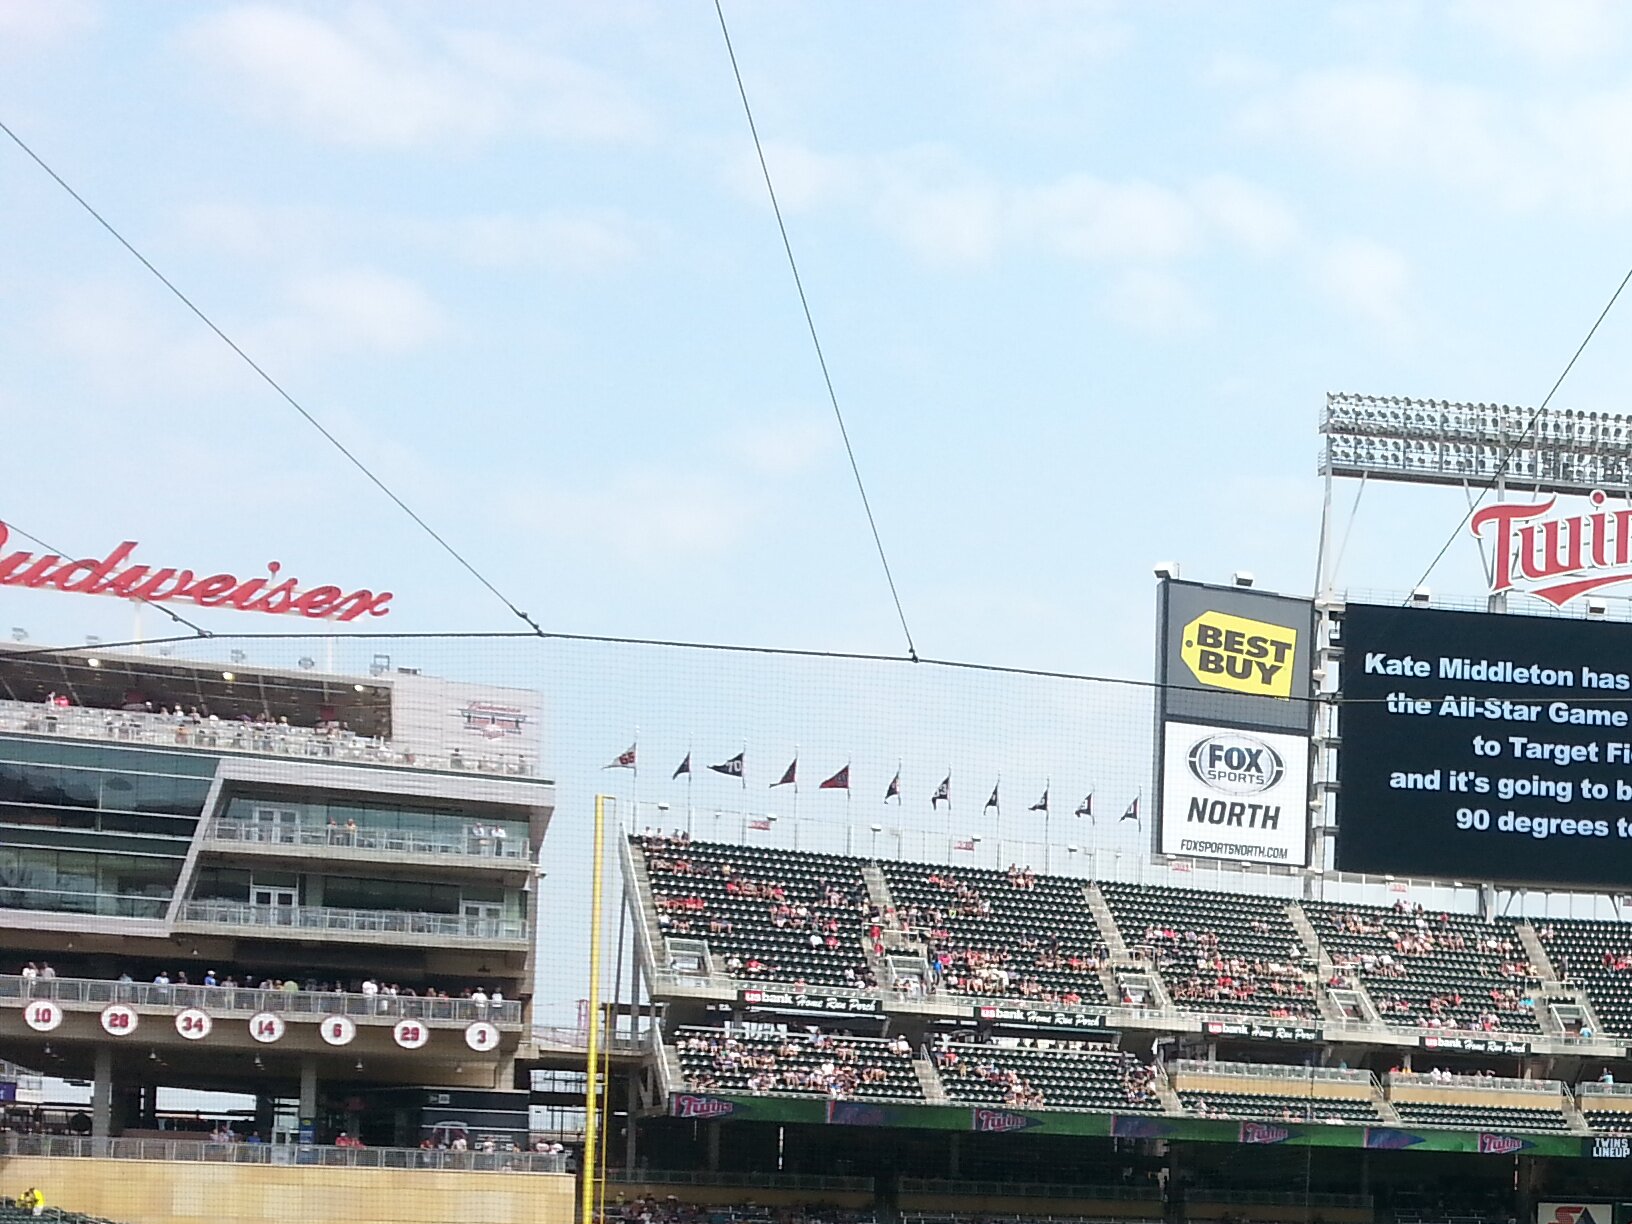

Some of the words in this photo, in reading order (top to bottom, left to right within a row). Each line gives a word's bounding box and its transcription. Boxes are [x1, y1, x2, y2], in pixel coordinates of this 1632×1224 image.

[0, 521, 393, 621] udweiser
[1197, 623, 1292, 663] BEST
[1199, 649, 1282, 685] BUY
[1364, 652, 1431, 678] Kate
[1438, 657, 1574, 687] Middleton
[1581, 666, 1630, 689] has
[1386, 692, 1432, 715] the
[1438, 695, 1542, 722] All-Star
[1548, 701, 1629, 727] Game
[1208, 743, 1263, 774] FOX
[1472, 735, 1502, 756] to
[1508, 736, 1599, 765] Target
[727, 760, 742, 772] 70
[1208, 769, 1265, 785] SPORTS
[1389, 769, 1441, 791] and
[1448, 770, 1491, 793] it's
[1497, 774, 1573, 803] going
[1580, 777, 1609, 799] to
[1187, 797, 1281, 830] NORTH
[1455, 807, 1490, 831] 90
[1497, 810, 1609, 839] degrees
[1180, 839, 1288, 859] FOXSPORTSNORTH.COM
[34, 1007, 52, 1023] 10
[109, 1012, 129, 1028] 28
[182, 1016, 204, 1032] 34
[257, 1020, 276, 1036] 14
[332, 1023, 342, 1038] 6
[401, 1026, 420, 1042] 29
[477, 1029, 487, 1044] 3
[1595, 1138, 1628, 1148] TWINS
[1592, 1148, 1631, 1158] LINEUP
